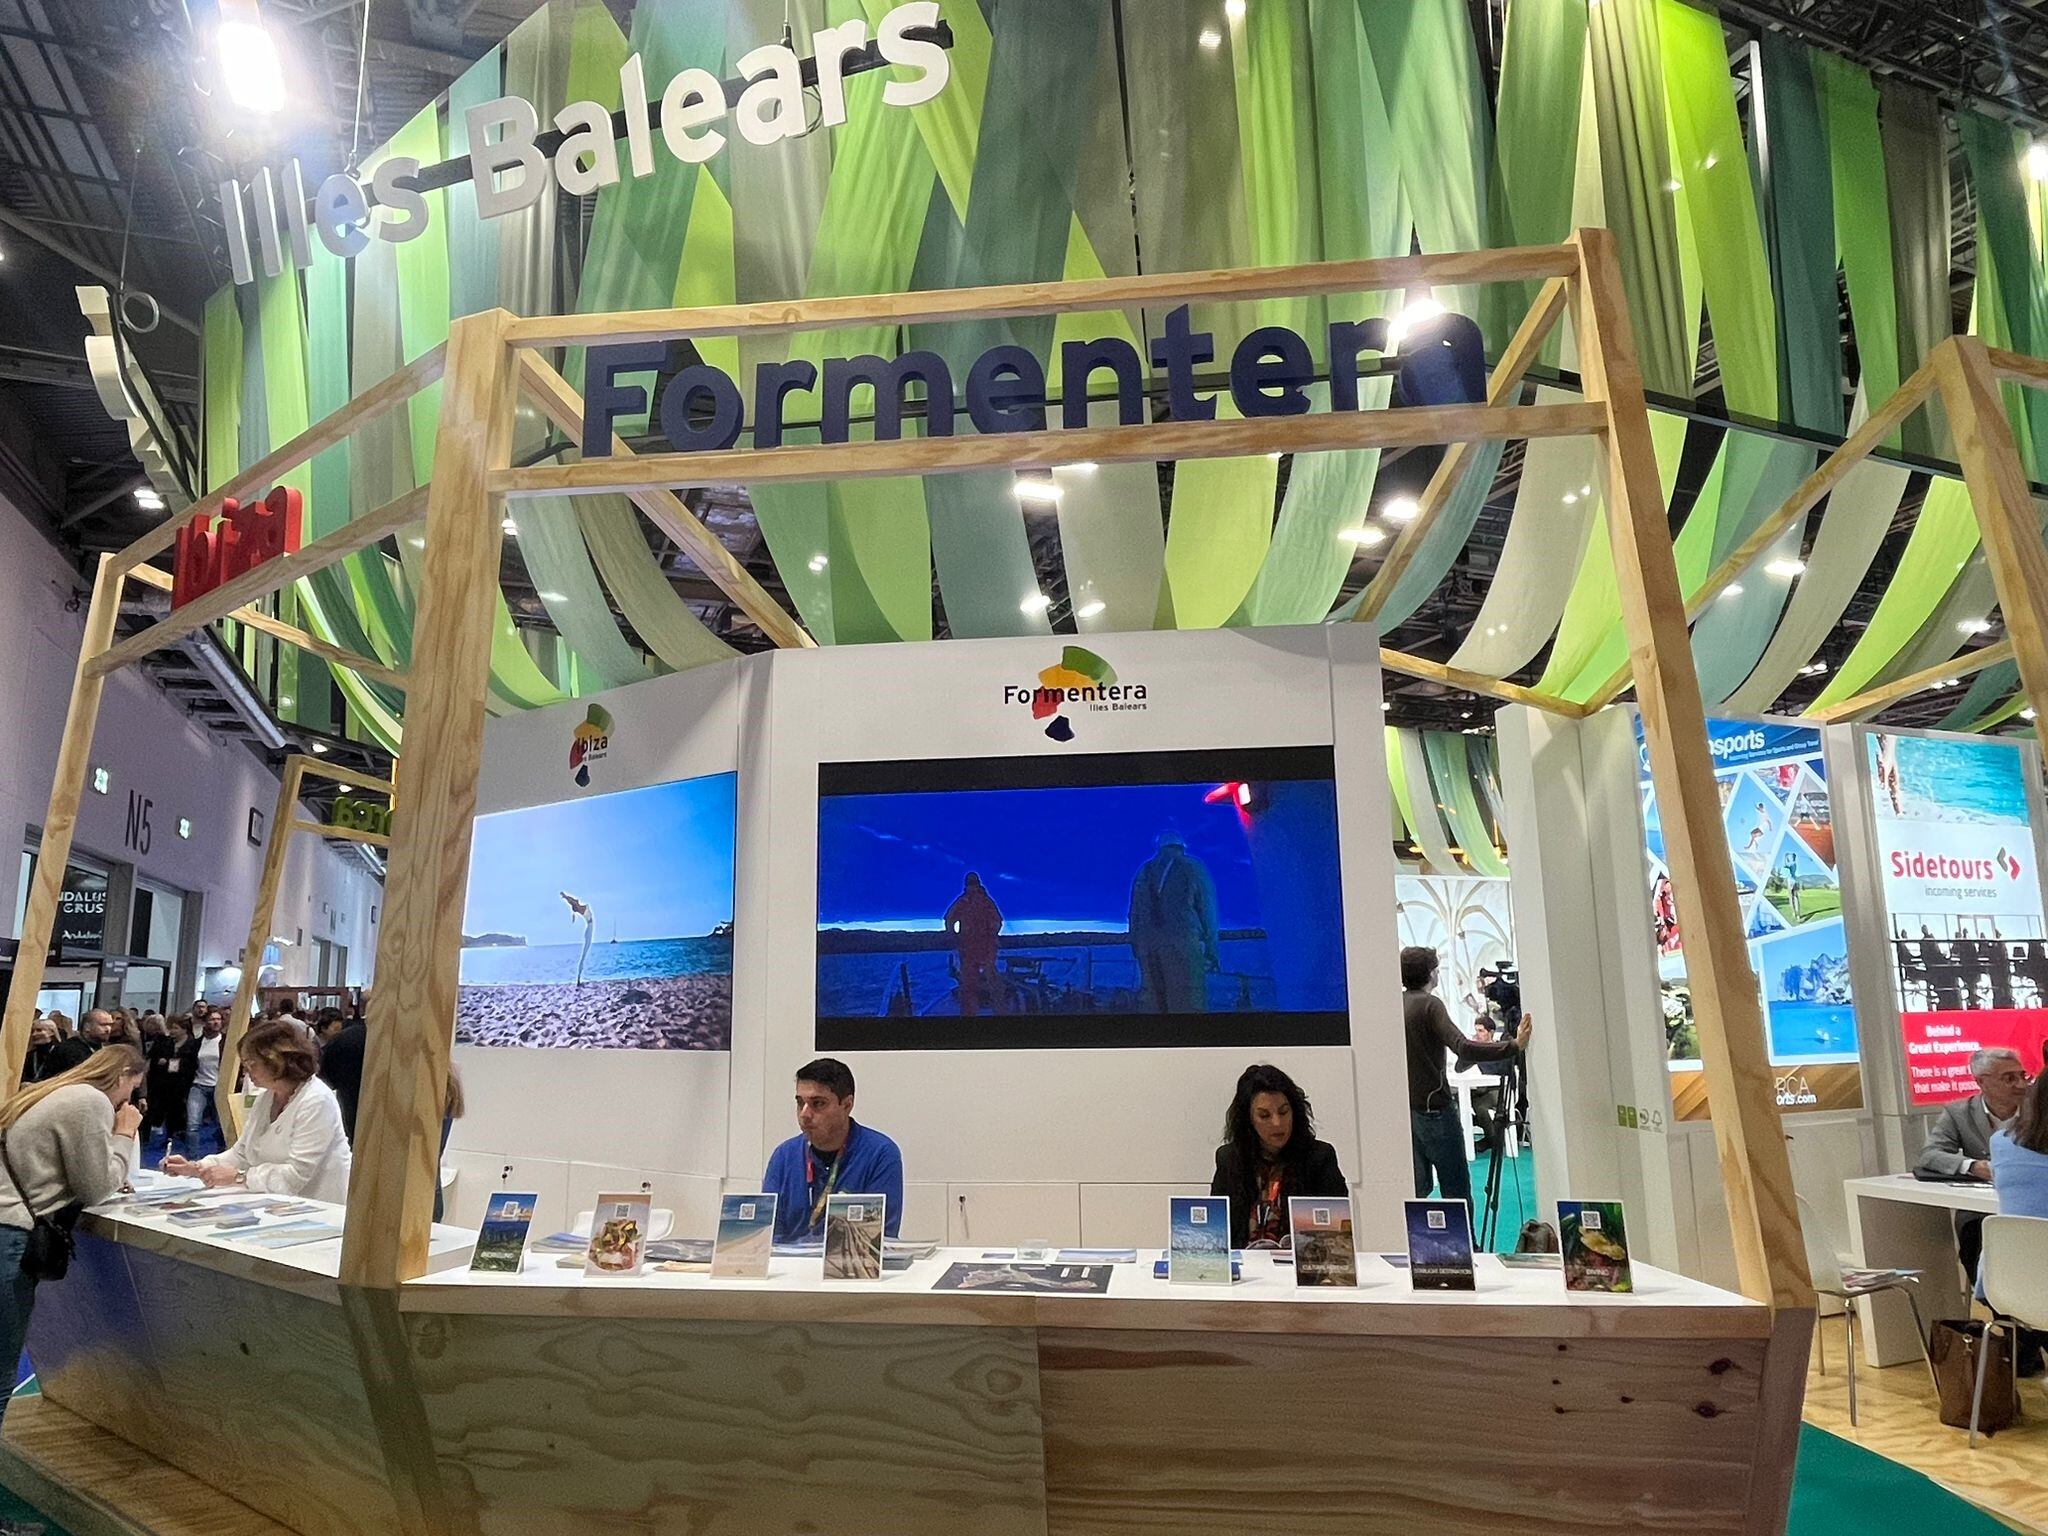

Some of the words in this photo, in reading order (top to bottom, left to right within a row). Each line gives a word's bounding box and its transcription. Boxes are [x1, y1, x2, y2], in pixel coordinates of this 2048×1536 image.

[221, 156, 429, 285] Illes
[465, 1, 950, 220] Balears
[581, 304, 1487, 458] Formentera
[1004, 682, 1147, 704] Formentera
[1089, 704, 1109, 712] Illes
[1112, 703, 1147, 711] Balears
[577, 735, 608, 757] Ibiza
[125, 789, 153, 855] N5
[1891, 851, 1993, 880] Sidetours
[1924, 884, 1963, 899] incoming
[1964, 886, 1998, 898] services
[1941, 1067, 1947, 1076] a
